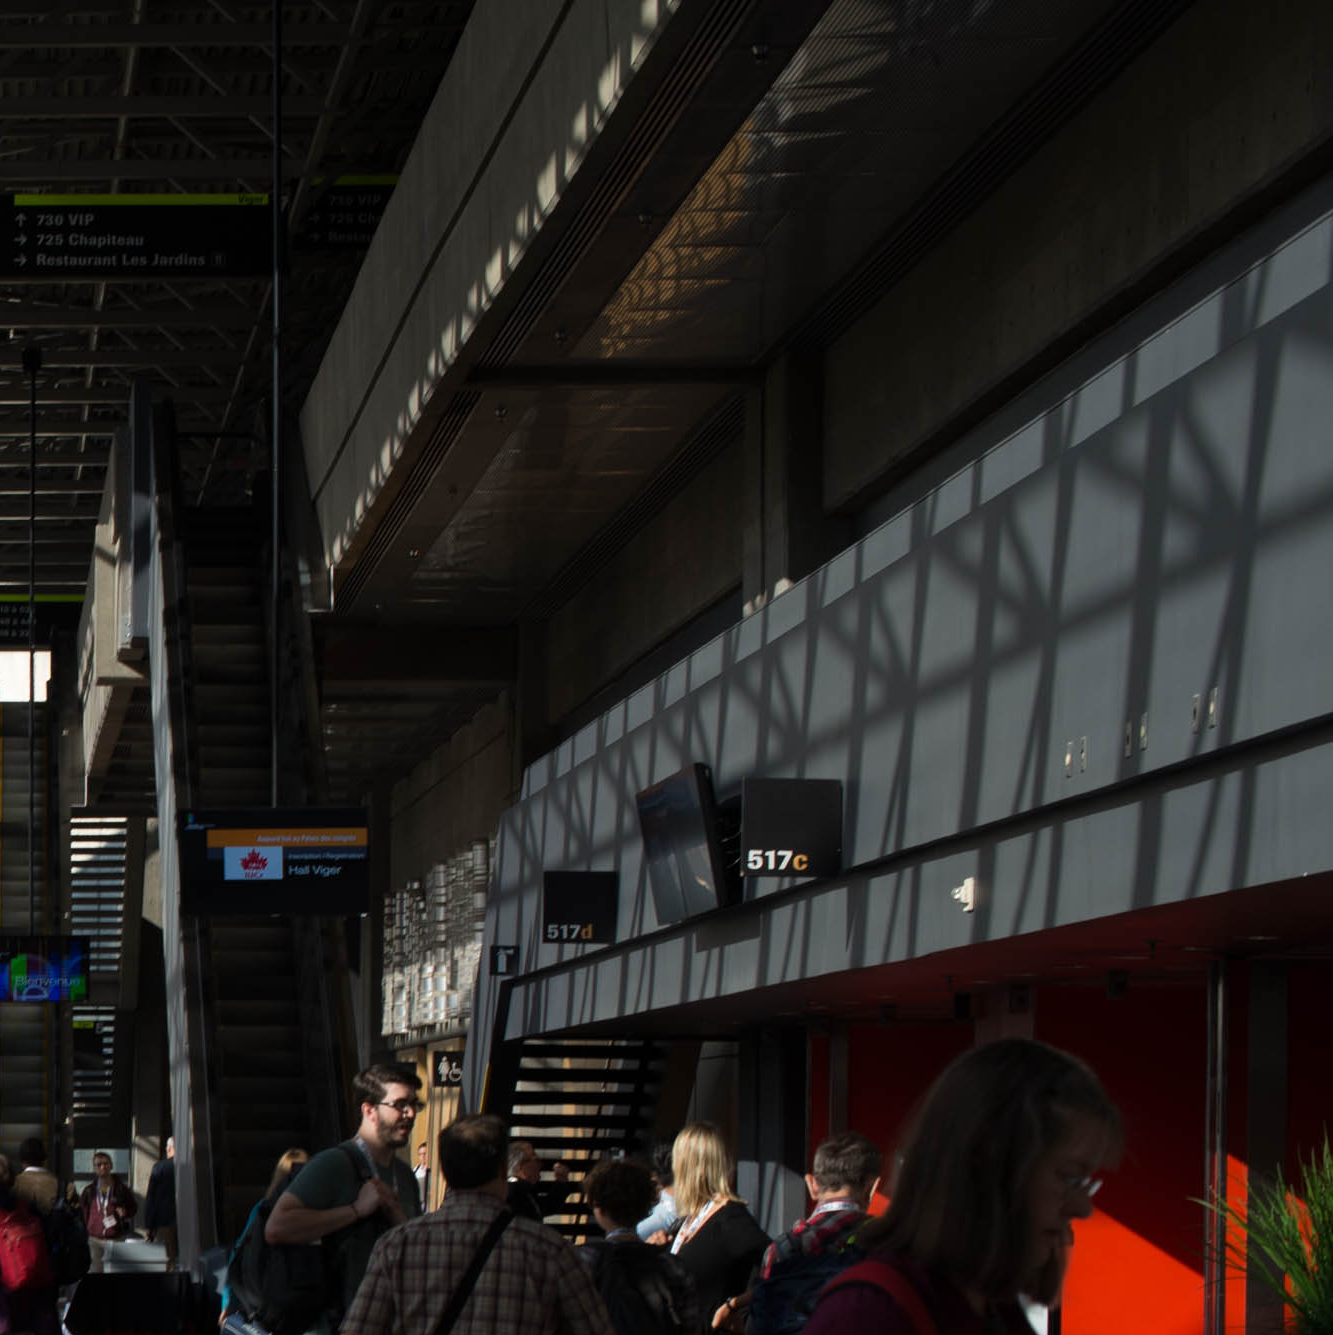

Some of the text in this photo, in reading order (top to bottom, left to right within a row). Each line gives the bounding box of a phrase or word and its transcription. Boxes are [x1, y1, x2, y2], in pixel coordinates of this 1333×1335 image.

[36, 214, 95, 226] 730 VIP
[36, 234, 145, 249] 725 Chapiteau
[36, 253, 206, 267] Restaurant Les Jardins
[746, 849, 809, 871] 517c
[288, 864, 342, 879] Hall Viger
[546, 922, 594, 940] 517d
